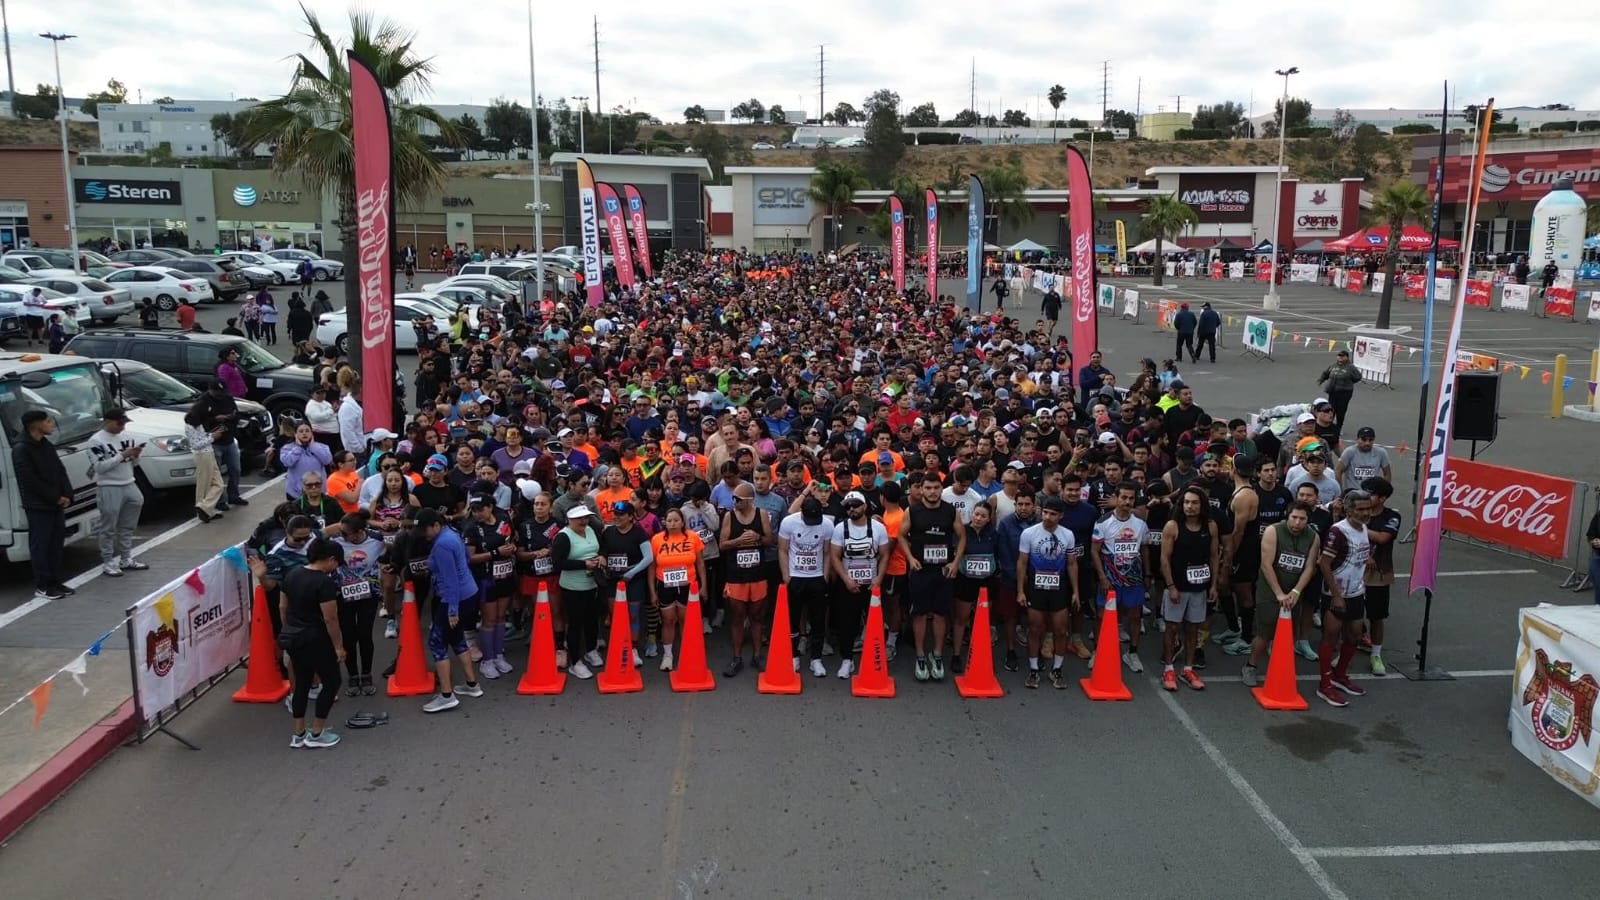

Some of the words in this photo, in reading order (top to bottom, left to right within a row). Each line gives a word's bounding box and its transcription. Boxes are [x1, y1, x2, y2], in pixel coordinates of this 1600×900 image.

[108, 184, 171, 199] Steren
[261, 189, 301, 204] AT&T
[442, 197, 474, 207] BBVA
[1544, 215, 1558, 260] FLASHLYTE
[1355, 469, 1375, 477] 0790
[659, 541, 691, 556] AKE
[1115, 543, 1137, 552] 2847
[737, 553, 759, 563] 0674
[925, 549, 946, 558] 1198
[608, 557, 628, 567] 3447
[967, 561, 990, 570] 2701
[1280, 554, 1305, 567] 3931
[664, 571, 686, 582] 1887
[850, 569, 871, 579] 1603
[1187, 567, 1210, 578] 1026
[1035, 575, 1059, 585] 2703
[342, 583, 369, 597] 0669
